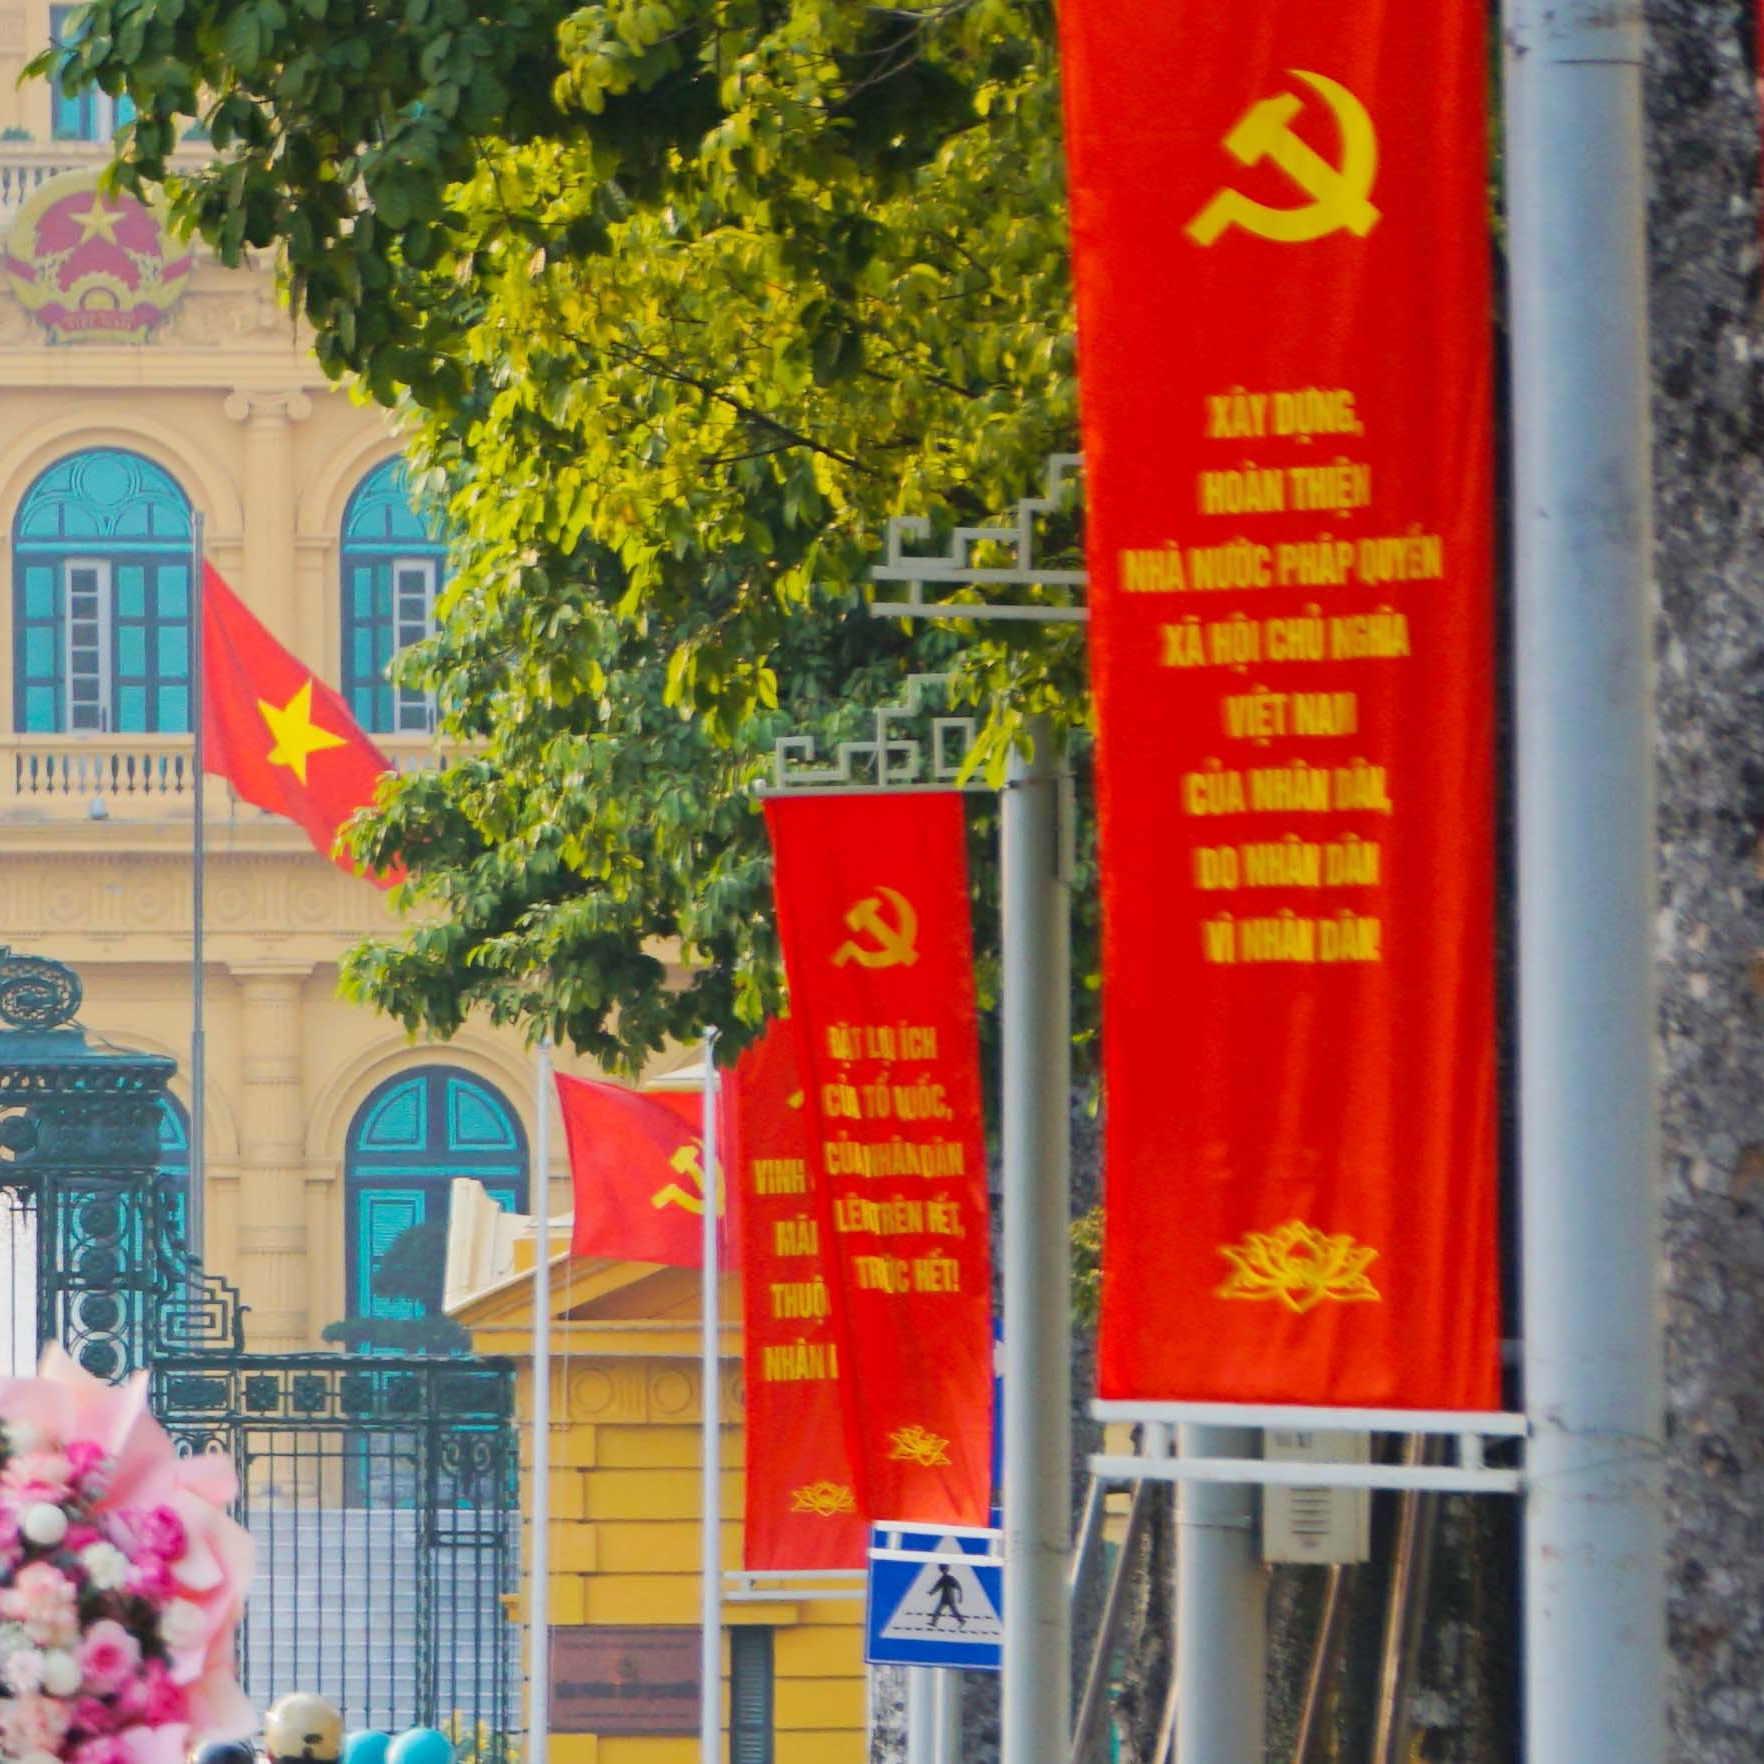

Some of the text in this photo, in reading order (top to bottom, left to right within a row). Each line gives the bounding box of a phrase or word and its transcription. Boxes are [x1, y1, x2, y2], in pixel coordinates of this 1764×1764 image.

[1206, 386, 1268, 438] XÂY
[1198, 455, 1371, 518] HOÀN THIỆN
[1119, 521, 1443, 592] NHÀ NƯỚC PHÁP QUYỀN
[1160, 602, 1411, 673] XÃ HỘI CHỦ NGHĨA
[1222, 682, 1288, 746] VIỆT
[1181, 756, 1246, 816] CỦA
[1249, 758, 1331, 813] NHÂN
[1193, 846, 1239, 890] DO
[1242, 832, 1321, 887] NHÂN
[1202, 910, 1236, 964] VÌ
[1239, 907, 1316, 963] NHÂN
[898, 1019, 938, 1060] ÍCH
[862, 1070, 890, 1119] TỔ
[752, 1158, 807, 1195] VINH
[774, 1213, 819, 1257] MÃI
[913, 1247, 961, 1293] HẾT!
[769, 1274, 832, 1325] THUỘ
[762, 1338, 826, 1382] NHÂN
